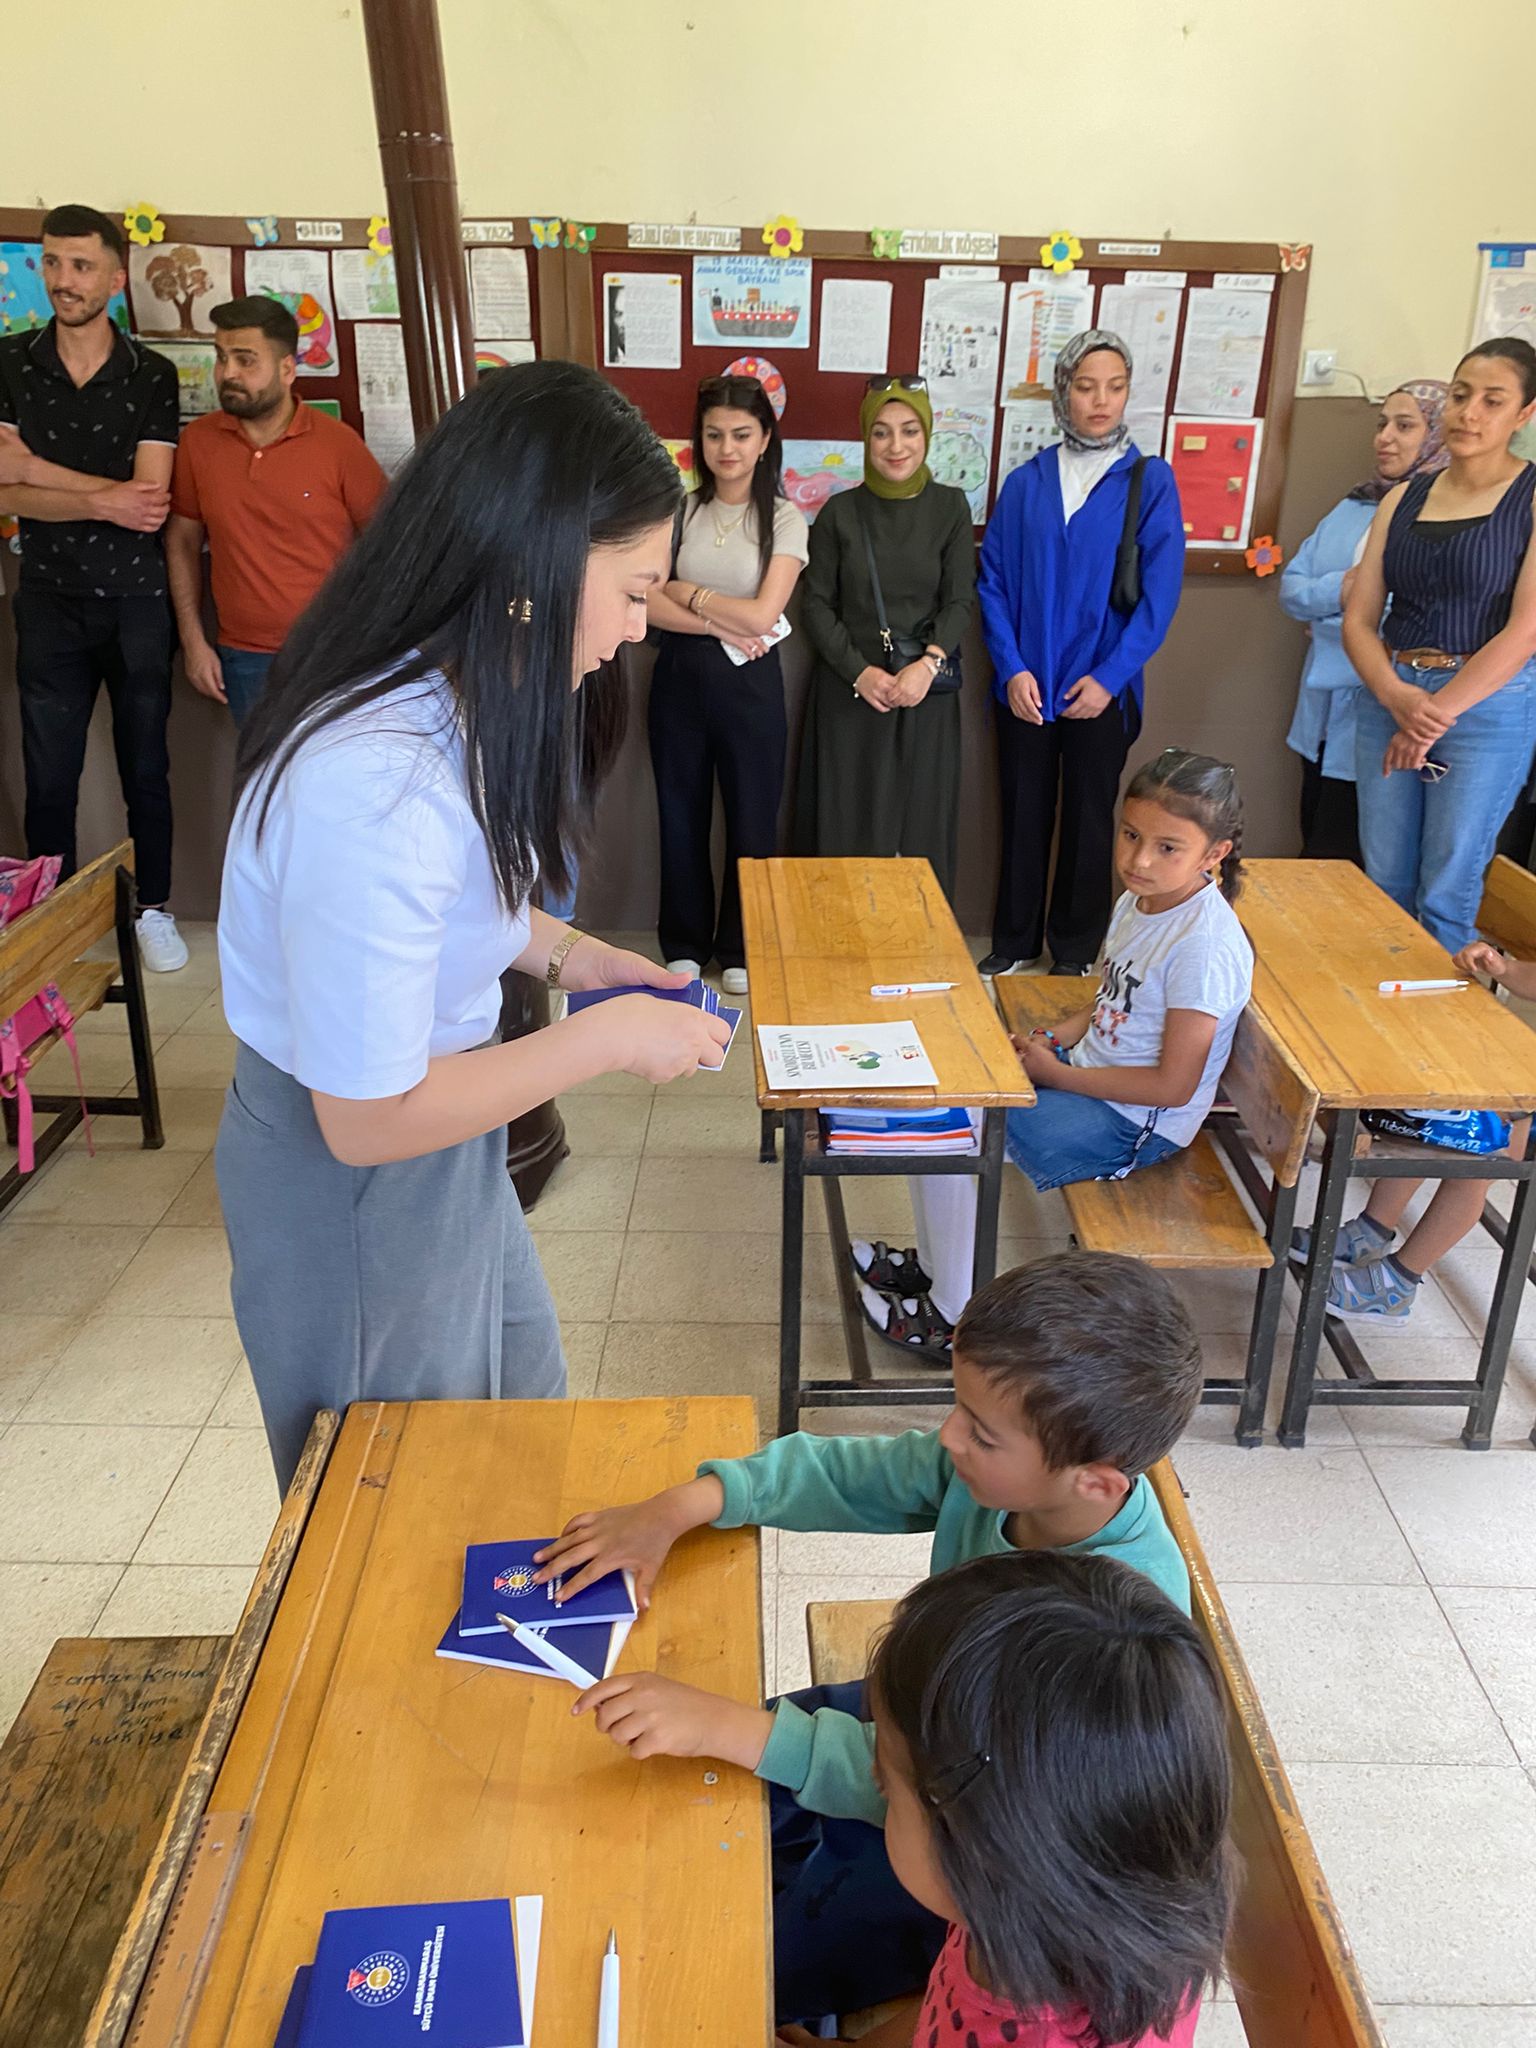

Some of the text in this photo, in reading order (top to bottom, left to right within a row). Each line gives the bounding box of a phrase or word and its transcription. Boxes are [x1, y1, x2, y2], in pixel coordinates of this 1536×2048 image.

[413, 1940, 432, 2016] KAHRAMANMARAŞ
[421, 1925, 446, 2032] SÜTÇÜ İMAM ÜNİVERSİTESİ
